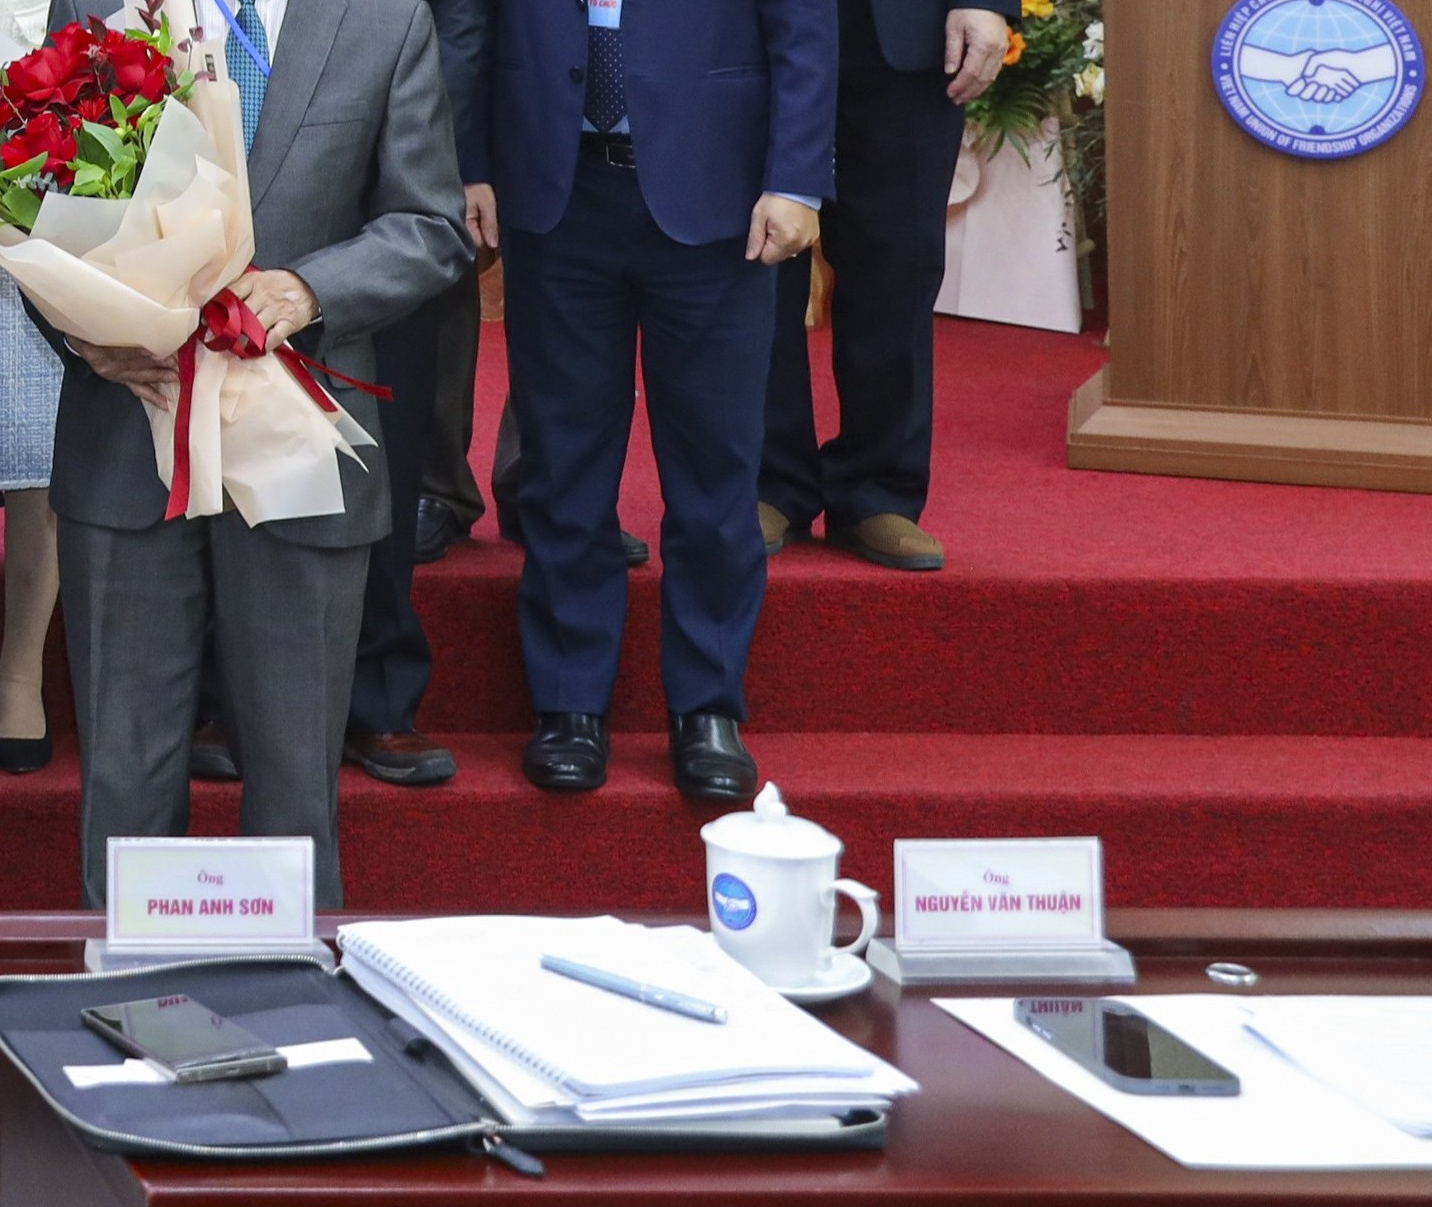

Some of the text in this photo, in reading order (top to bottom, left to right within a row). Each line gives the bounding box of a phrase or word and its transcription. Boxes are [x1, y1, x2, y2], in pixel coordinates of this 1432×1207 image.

[1398, 33, 1418, 62] NAM
[1276, 133, 1292, 147] OF
[1292, 138, 1357, 154] FRIENDSHIP
[1357, 83, 1418, 146] ORGANIZATIONS
[197, 869, 224, 886] Ông
[983, 868, 1010, 886] Ông
[147, 897, 274, 916] PHAN ANH SƠN
[915, 889, 1081, 915] NGUYỄN VĂN THUẬN
